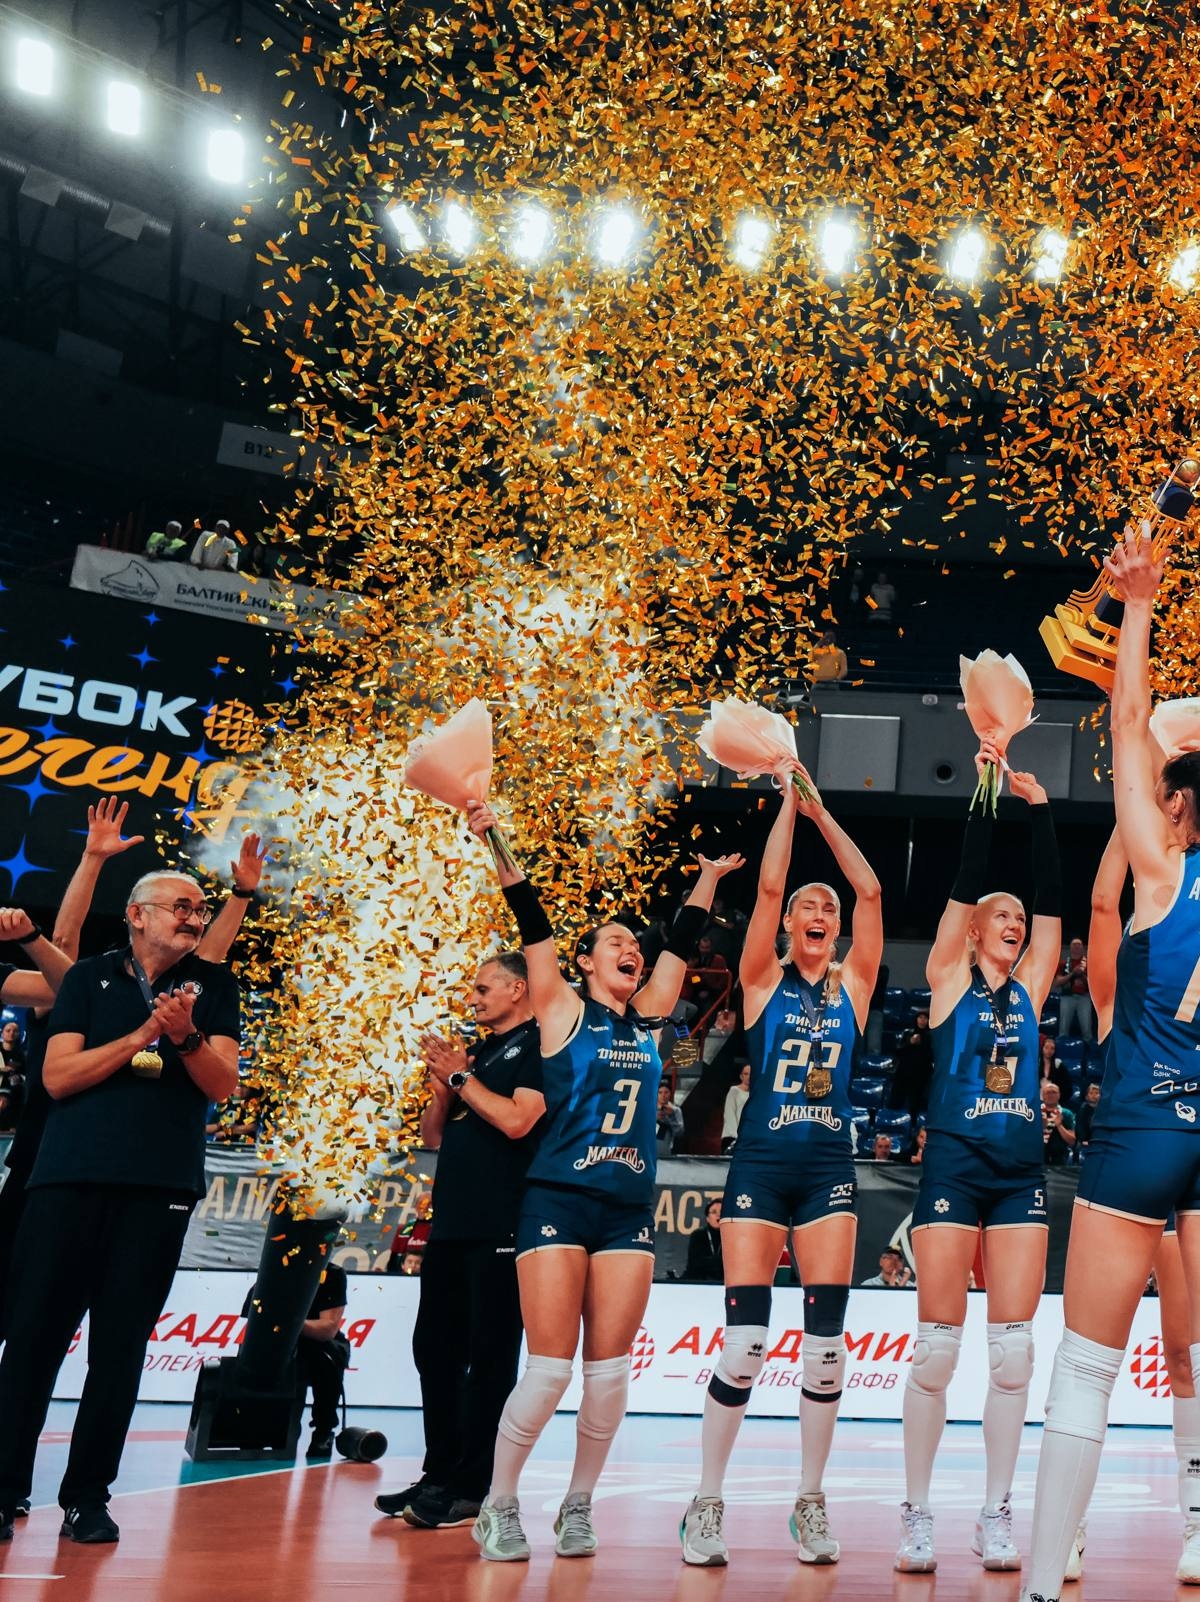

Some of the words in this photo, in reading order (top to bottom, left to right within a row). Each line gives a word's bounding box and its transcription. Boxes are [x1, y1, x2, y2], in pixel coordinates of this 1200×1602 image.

[597, 1047, 651, 1063] ДИНАМО
[601, 1078, 642, 1135] 3
[1034, 1188, 1044, 1207] 5
